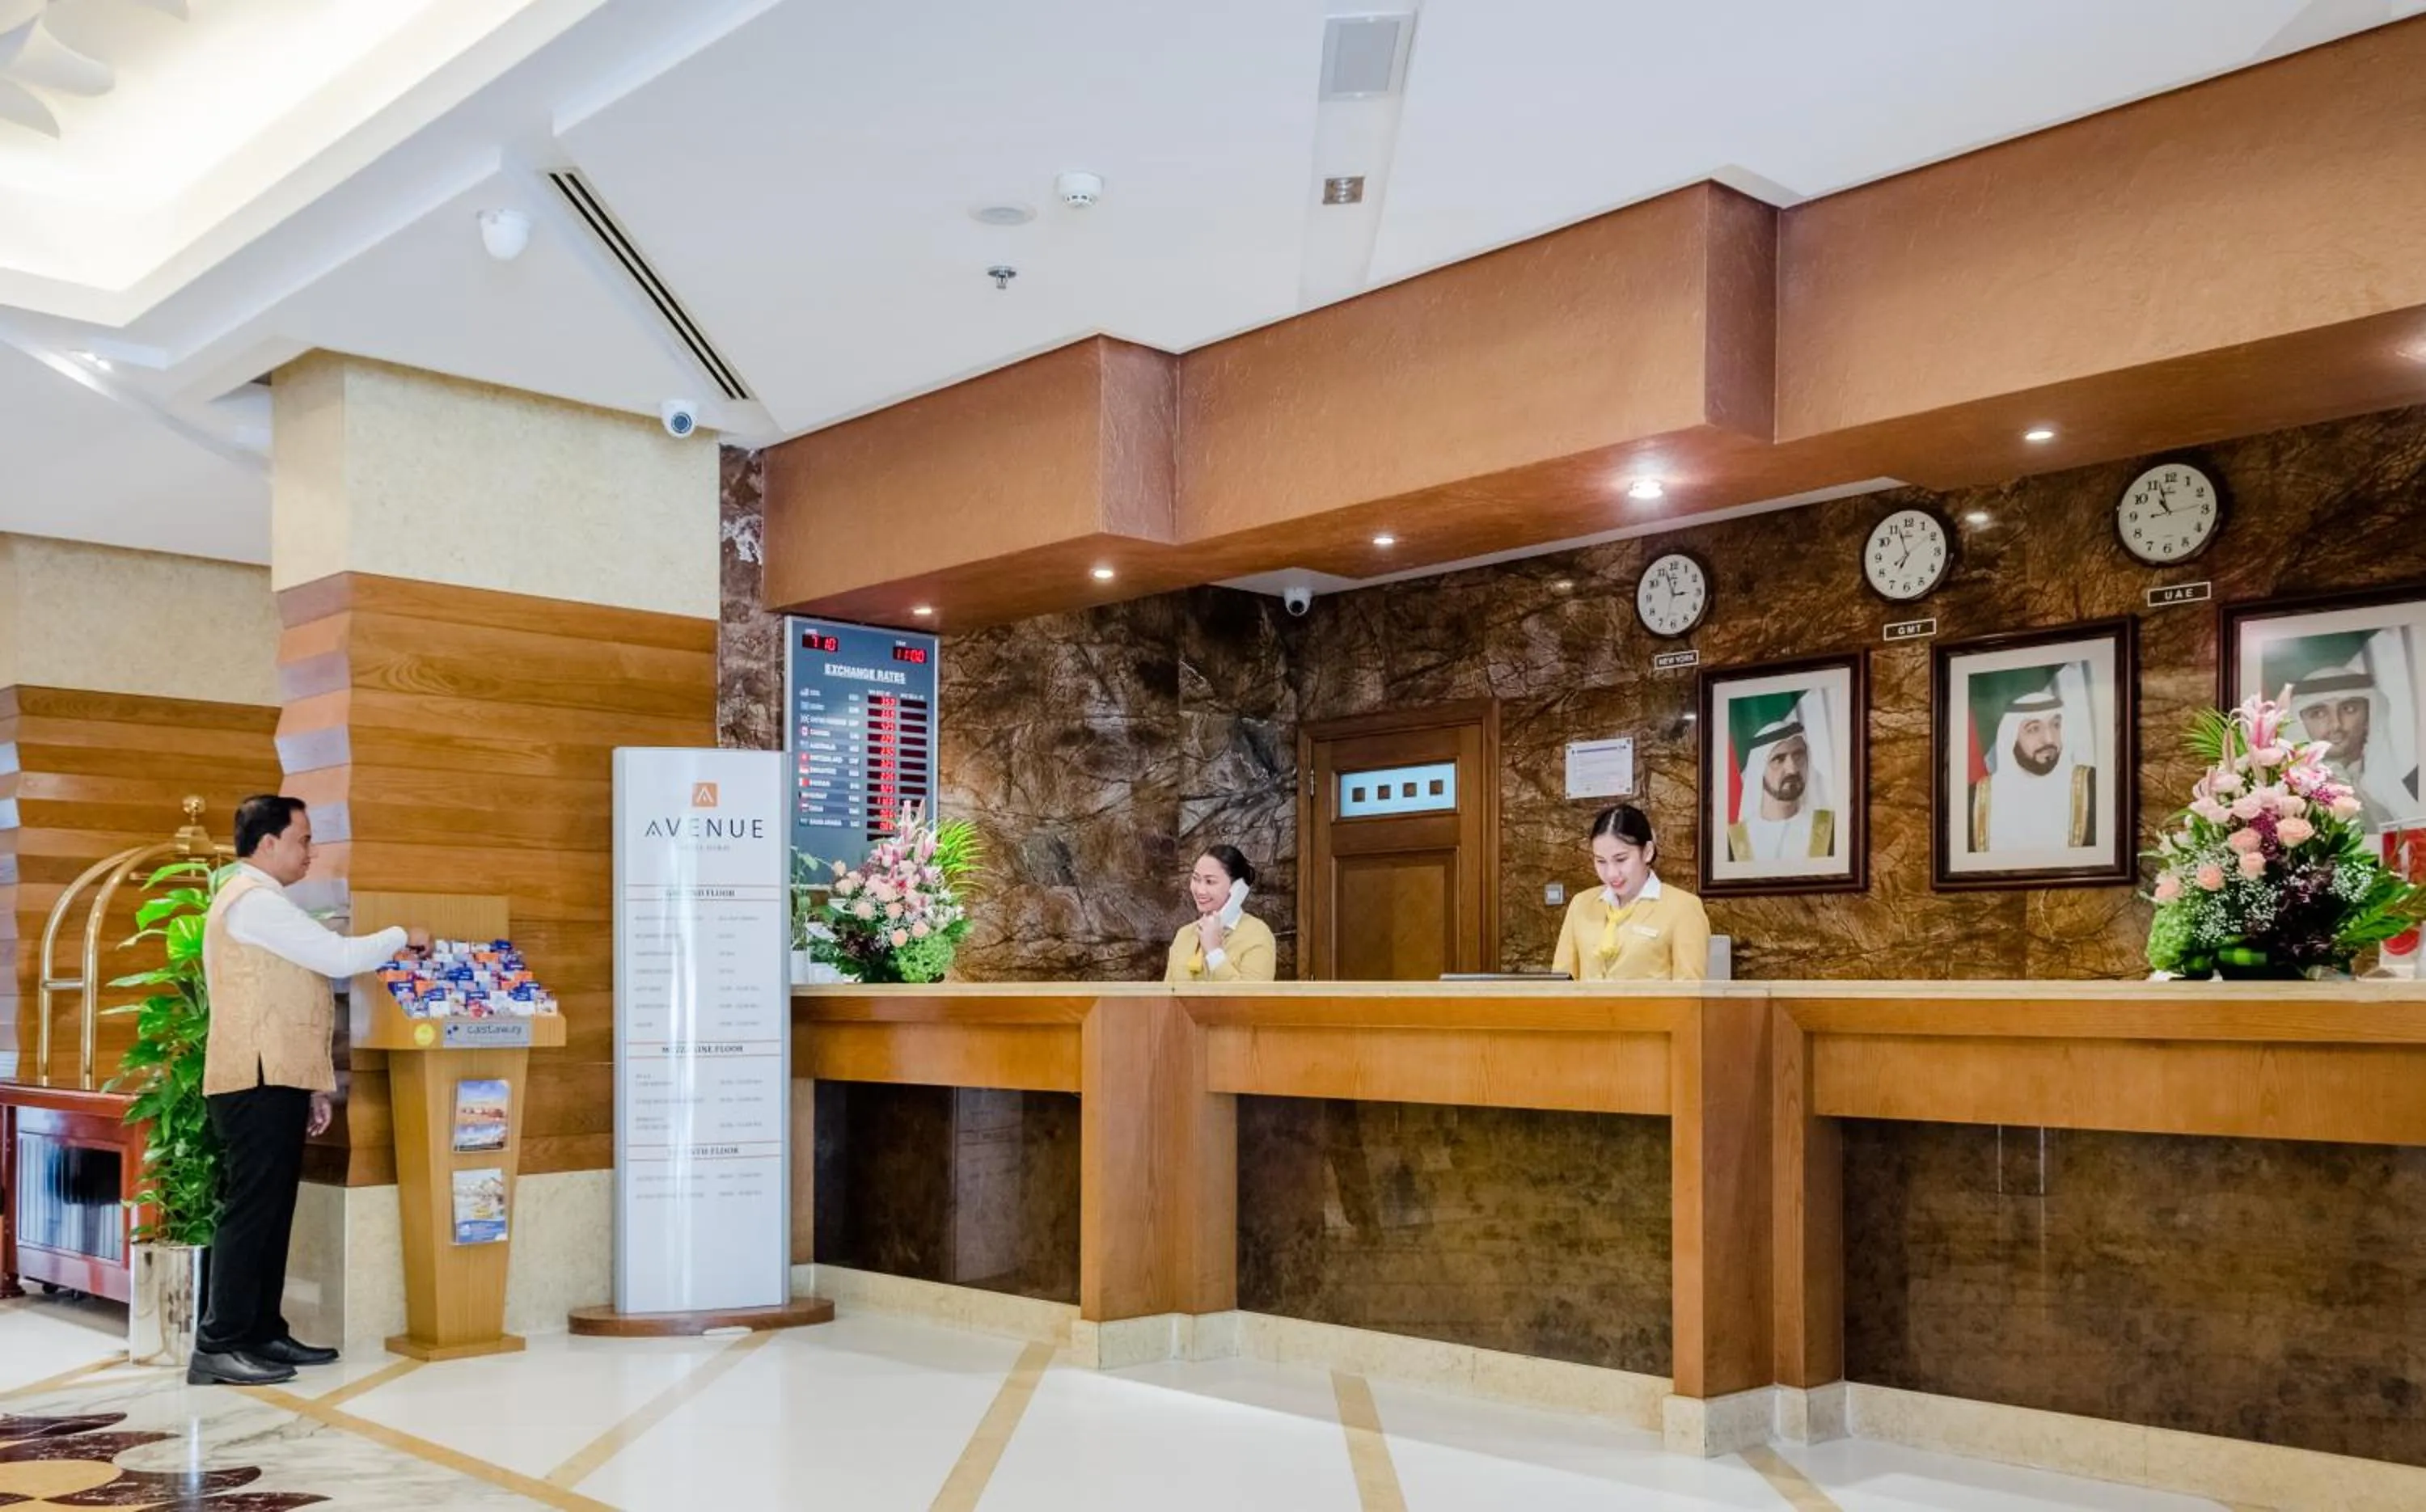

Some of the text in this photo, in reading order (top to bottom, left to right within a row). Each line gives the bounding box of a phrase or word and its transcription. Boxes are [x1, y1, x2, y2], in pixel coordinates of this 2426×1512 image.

[2165, 472, 2178, 483] 12
[2185, 475, 2191, 487] 1
[2147, 480, 2158, 491] 11
[2196, 487, 2204, 497] 2
[2134, 492, 2149, 505] 10
[2200, 504, 2210, 515] 3
[2129, 512, 2138, 522] 9
[1903, 517, 1914, 528] 12
[1920, 522, 1926, 531] 1
[1889, 525, 1899, 534] 11
[2133, 528, 2142, 538] 8
[1929, 532, 1937, 541] 2
[2145, 541, 2154, 551] 7
[2163, 543, 2172, 554] 6
[1934, 547, 1942, 556] 3
[1874, 553, 1883, 563] 9
[1669, 562, 1679, 571] 12
[1684, 564, 1688, 573] 1
[1657, 568, 1665, 577] 11
[1878, 568, 1886, 577] 8
[1888, 580, 1896, 589] 7
[1903, 582, 1911, 593] 6
[2165, 588, 2194, 601] UAE
[1658, 618, 1663, 627] 7
[1898, 624, 1922, 635] GMT
[824, 663, 907, 685] EXCHANGE RATES
[645, 817, 764, 838] AVENUE
